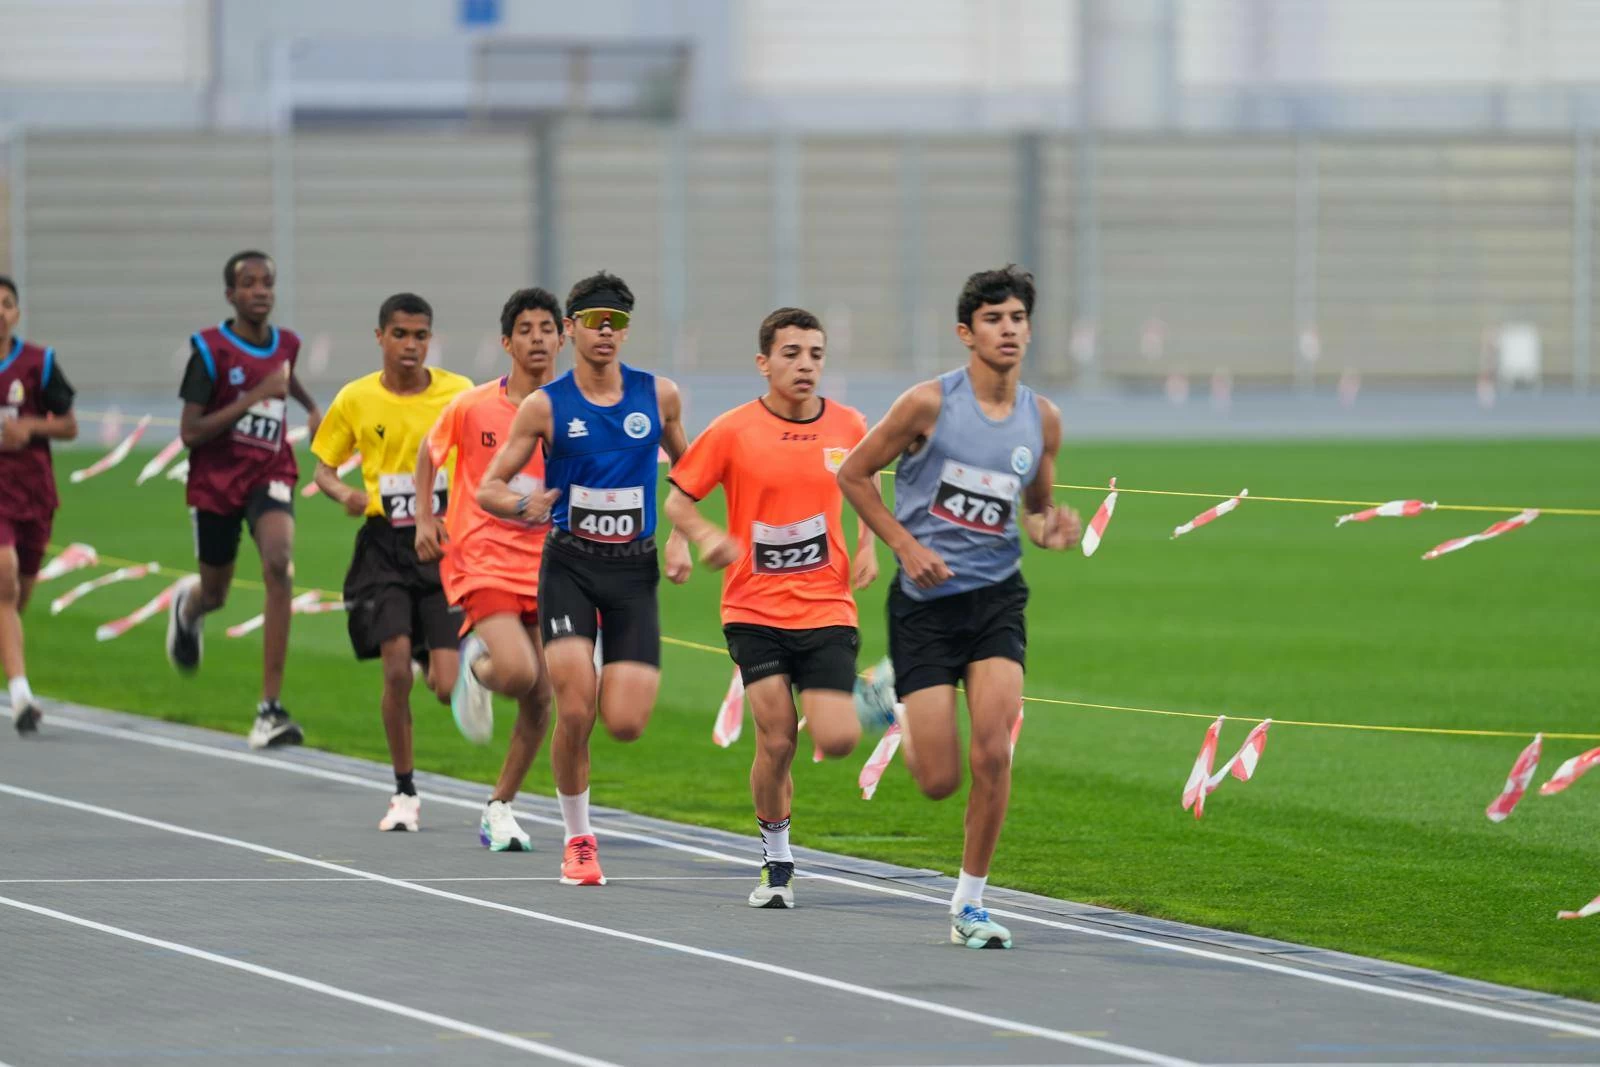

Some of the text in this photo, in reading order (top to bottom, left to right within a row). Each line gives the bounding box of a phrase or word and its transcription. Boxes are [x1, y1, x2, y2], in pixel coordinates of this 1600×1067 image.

[943, 492, 1004, 526] 476
[578, 513, 634, 537] 400
[764, 543, 822, 569] 322
